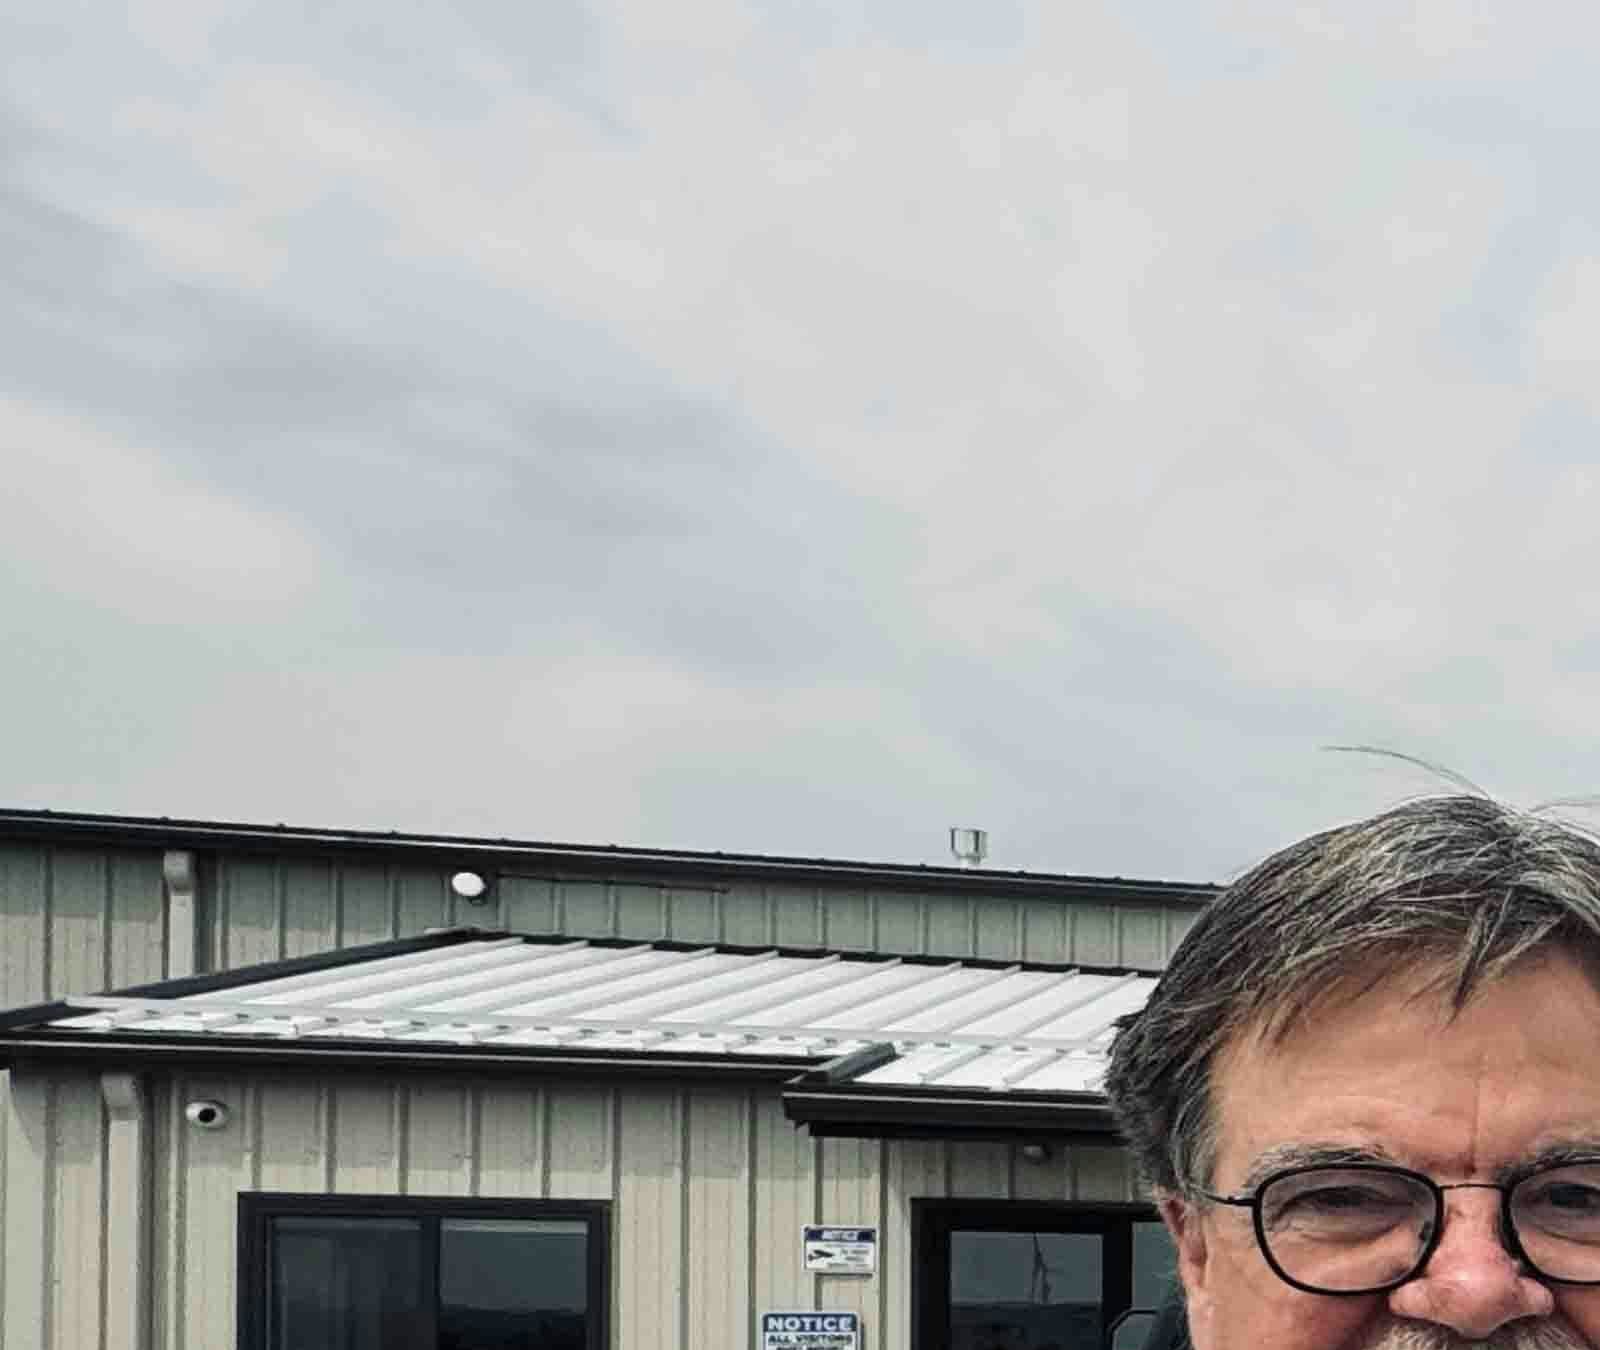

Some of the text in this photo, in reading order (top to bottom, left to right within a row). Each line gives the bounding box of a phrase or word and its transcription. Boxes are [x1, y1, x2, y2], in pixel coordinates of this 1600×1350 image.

[767, 1316, 853, 1331] NOTICE
[768, 1334, 853, 1345] ALL VISITORS
